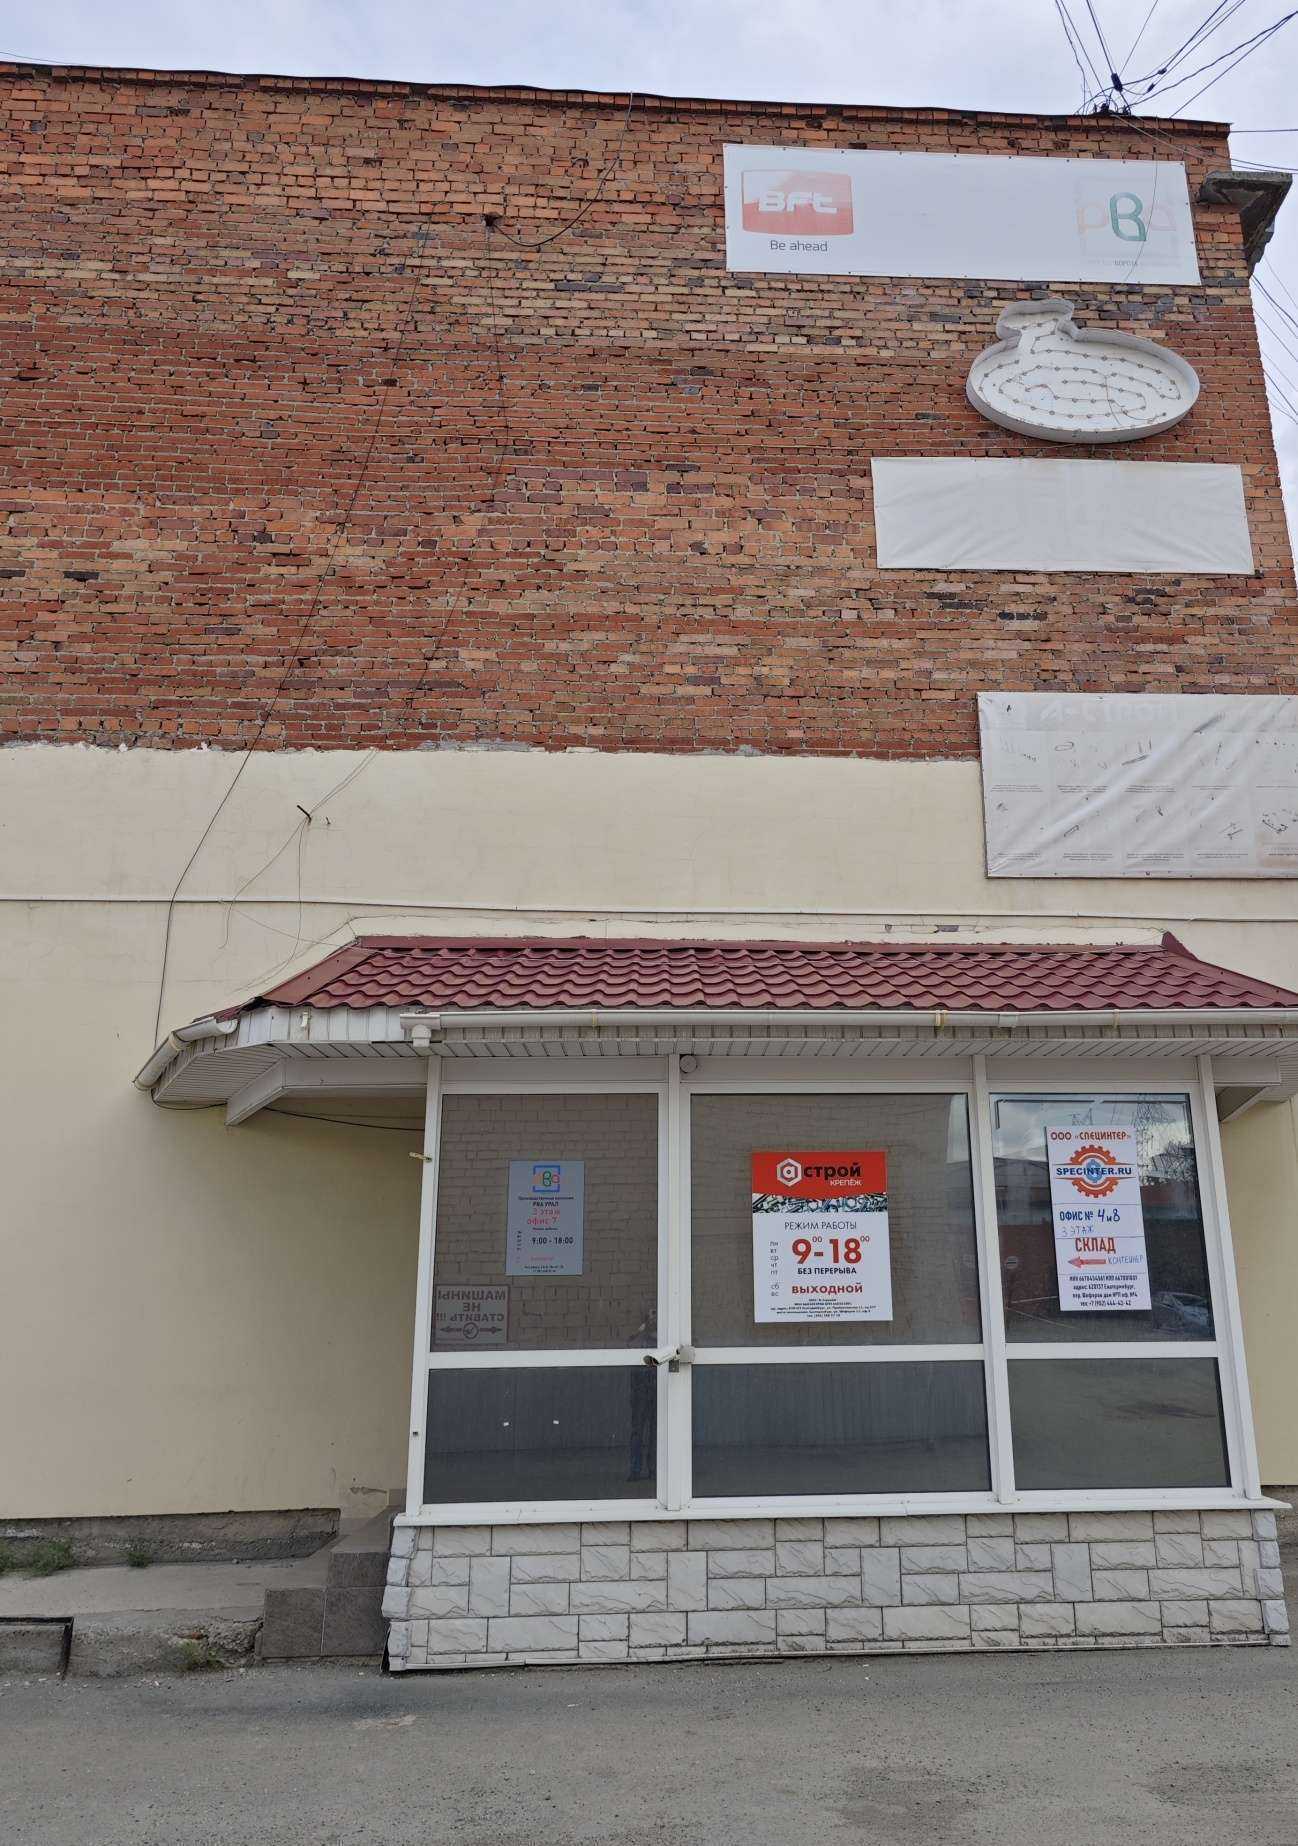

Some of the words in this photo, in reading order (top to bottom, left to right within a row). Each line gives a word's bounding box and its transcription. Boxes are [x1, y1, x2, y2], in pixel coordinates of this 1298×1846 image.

[770, 239, 786, 251] Be
[790, 240, 828, 251] ahead
[1050, 1131, 1072, 1141] ООО
[1056, 1167, 1132, 1176] SPECINTER.RU
[1059, 1210, 1083, 1221] ОФИС
[784, 1221, 819, 1230] РЕЖИМ
[821, 1221, 857, 1230] РАБОТЫ
[1075, 1237, 1117, 1255] СКЛАД
[797, 1267, 812, 1275] БЕЗ
[814, 1267, 857, 1275] ПЕРЕРЫВА
[791, 1282, 863, 1295] ВЫХОДНОЙ
